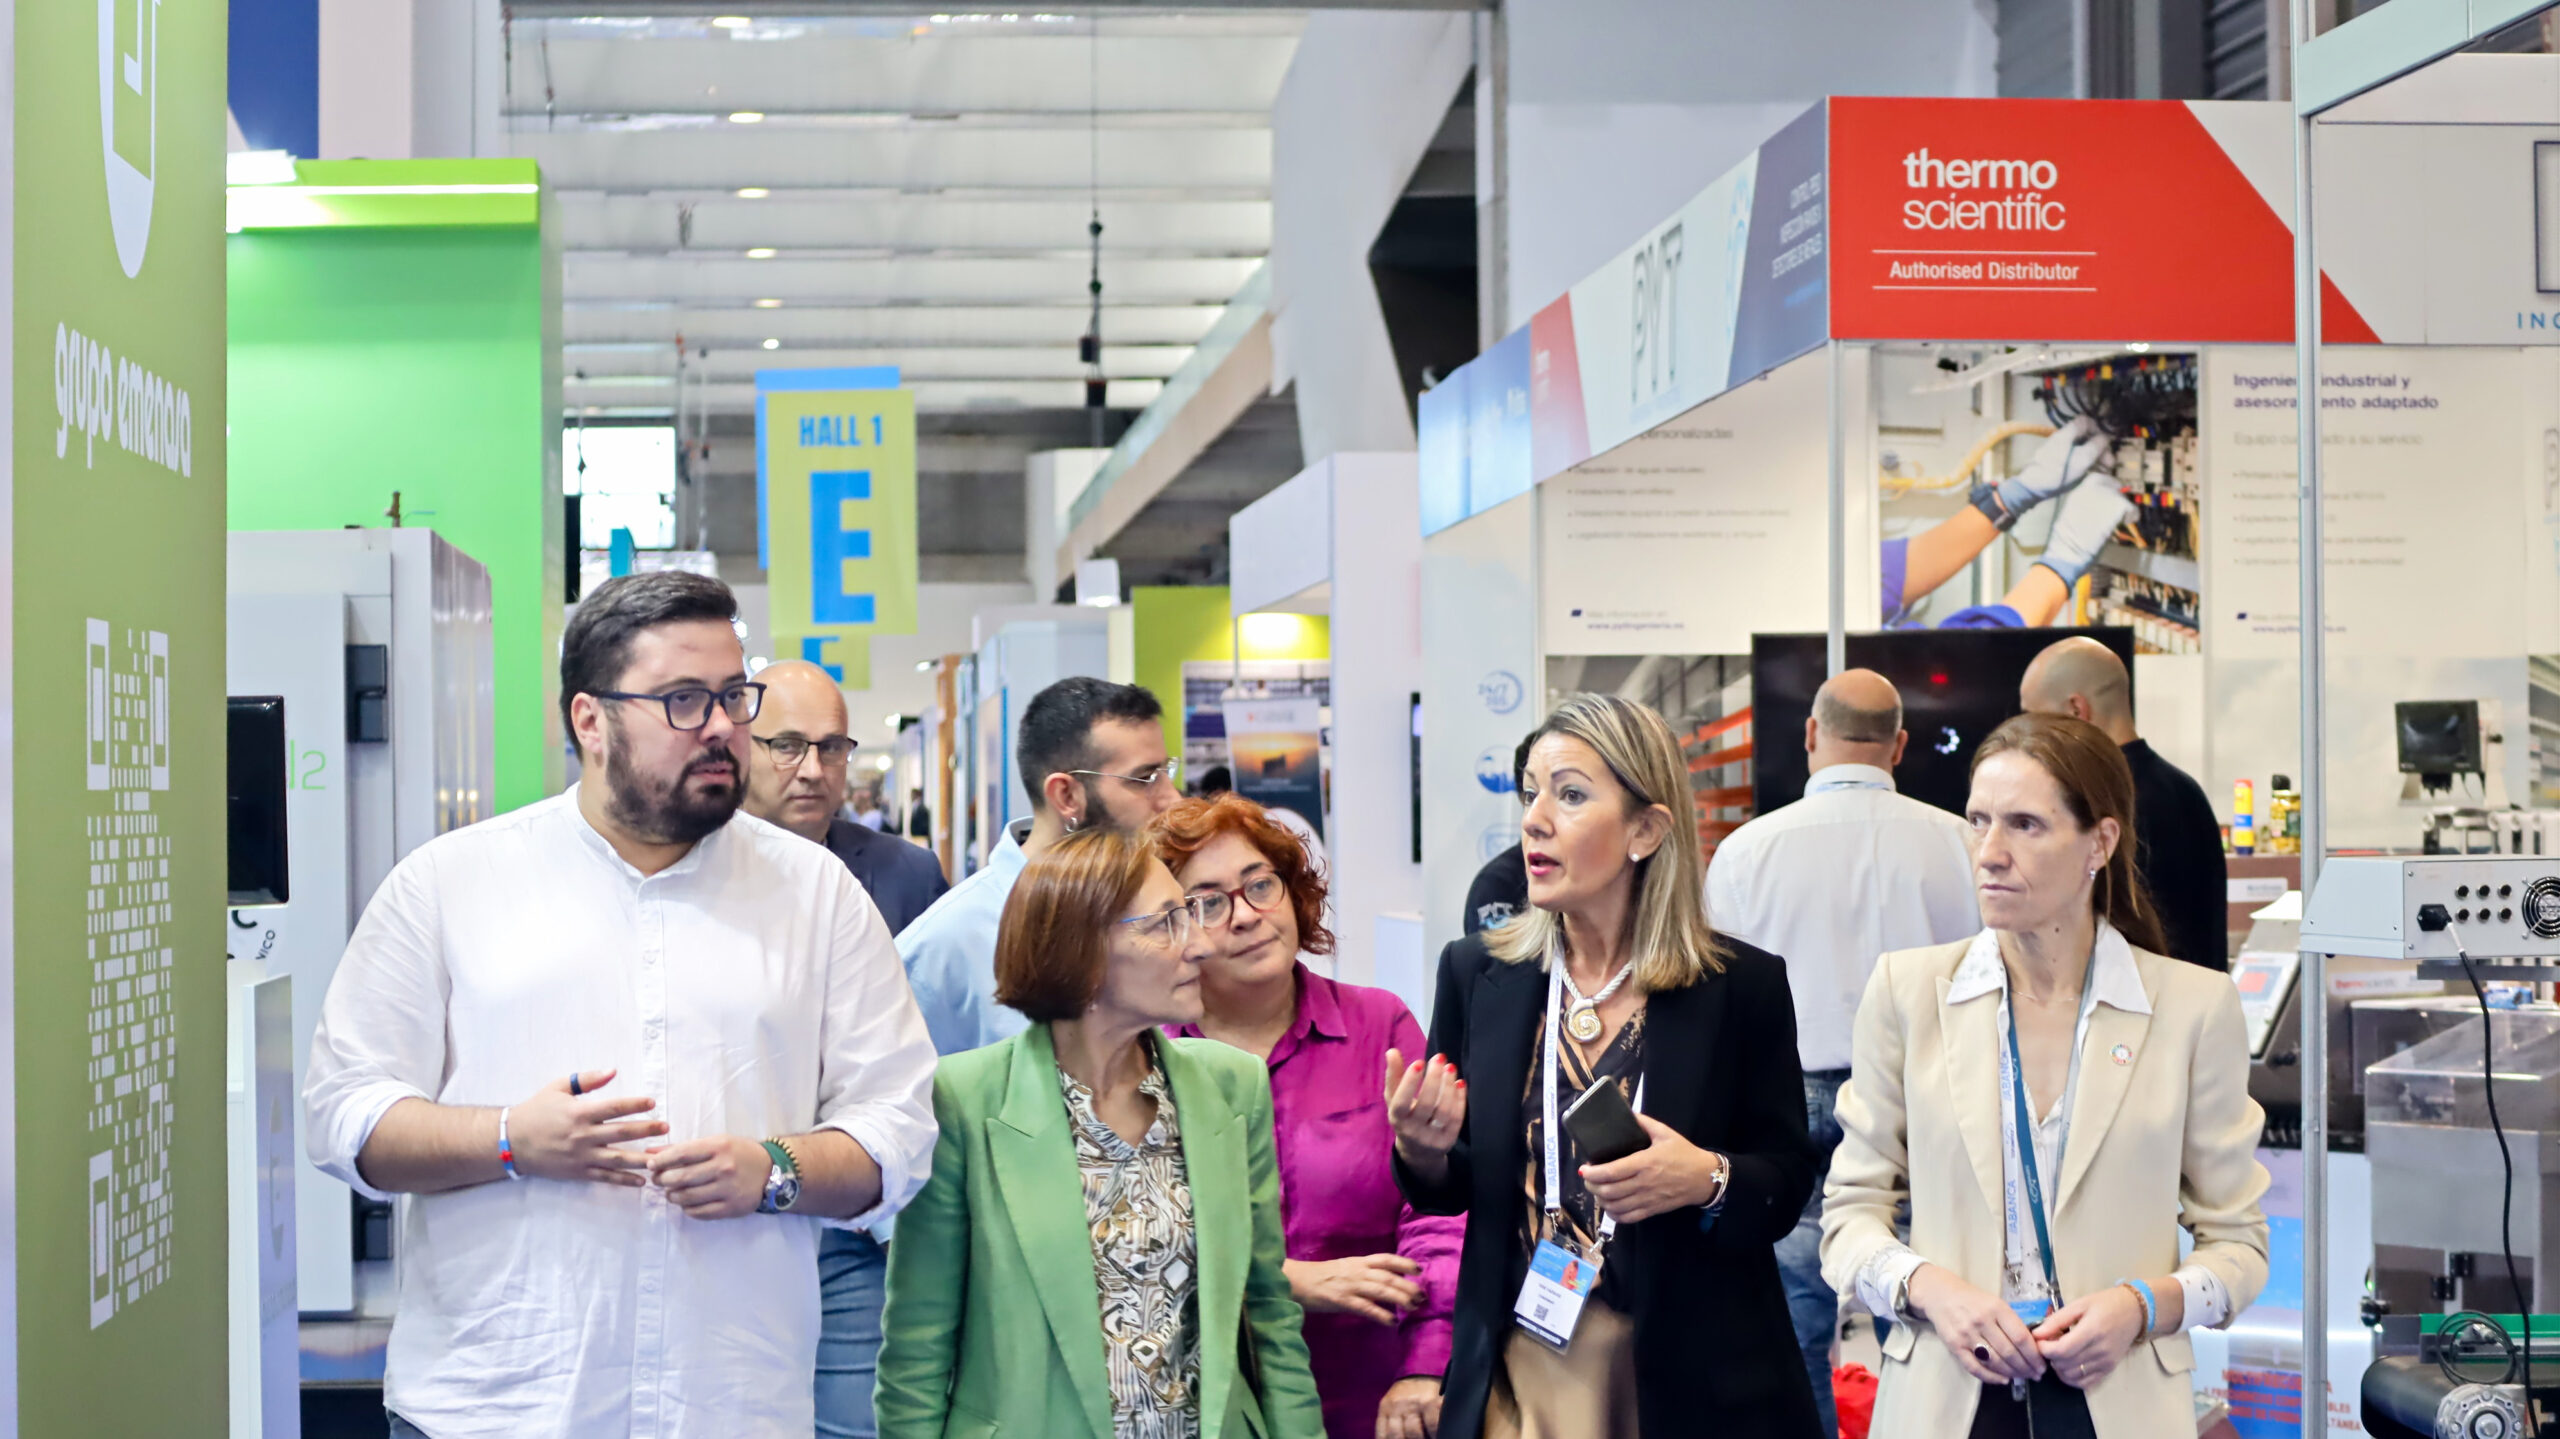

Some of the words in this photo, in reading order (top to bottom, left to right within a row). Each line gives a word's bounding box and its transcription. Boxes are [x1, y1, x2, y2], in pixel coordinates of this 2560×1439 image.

[1903, 148, 2057, 189] thermo
[1903, 192, 2066, 231] scientific
[1889, 261, 1982, 279] Authorised
[1988, 261, 2079, 280] Distributor
[55, 321, 113, 470] grupo
[2321, 374, 2396, 387] industrial
[2401, 377, 2410, 389] y
[2234, 395, 2356, 409] asesoraento
[2361, 395, 2439, 411] adaptado
[799, 415, 861, 447] HALL
[870, 414, 883, 446] 1
[809, 469, 876, 625] E
